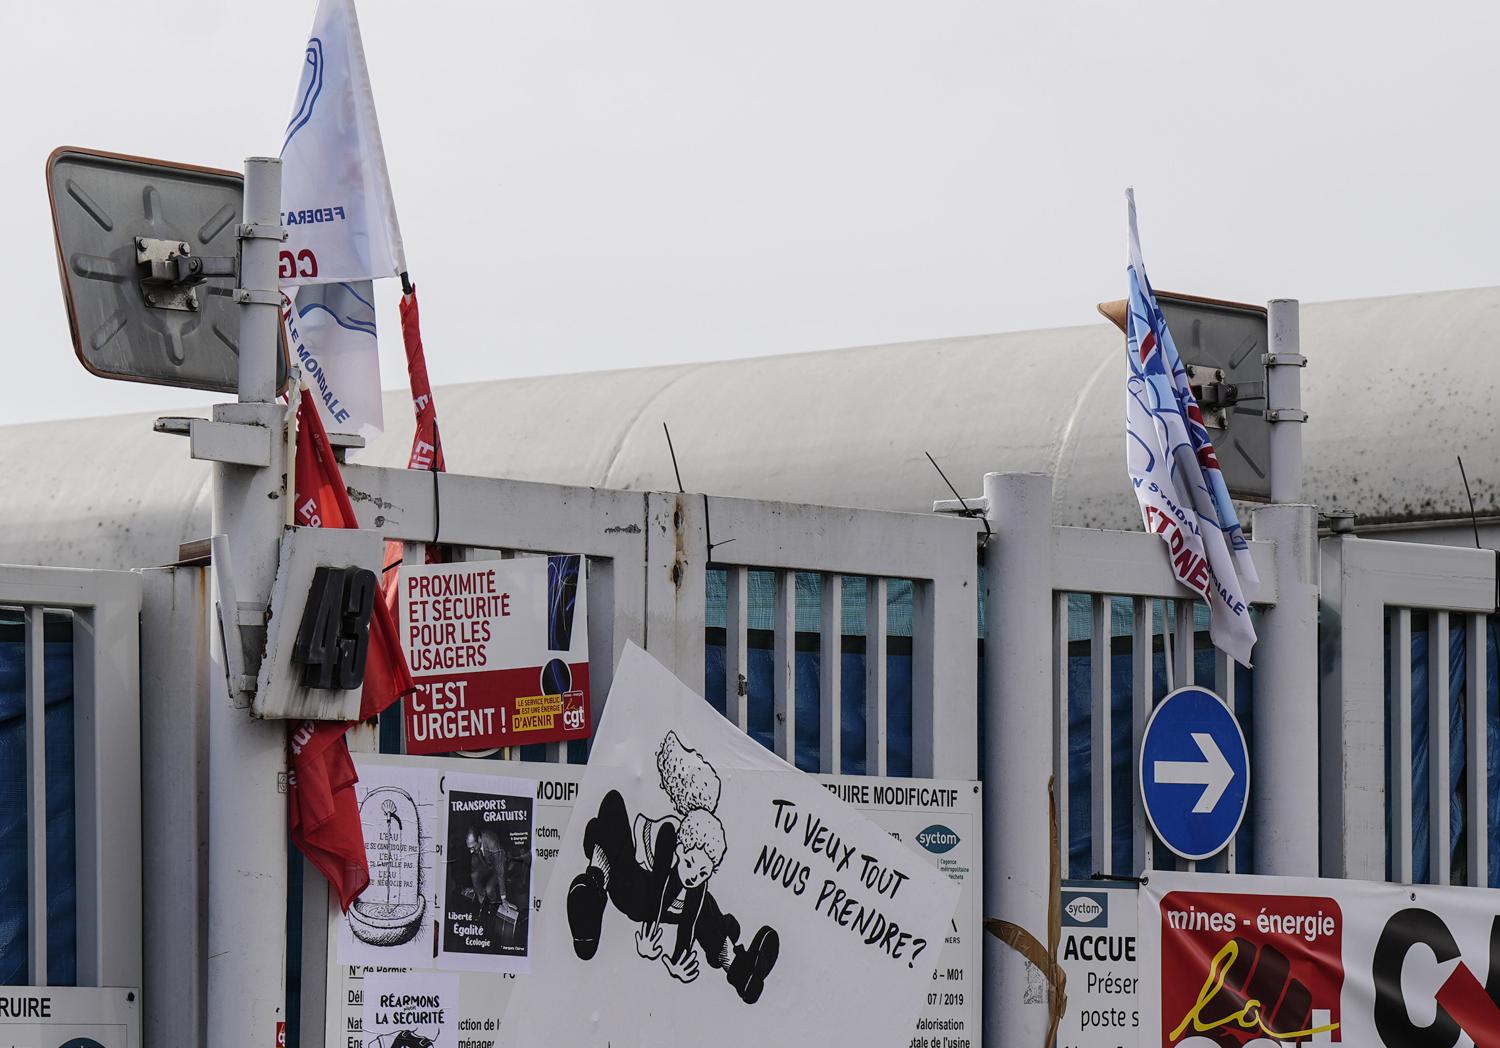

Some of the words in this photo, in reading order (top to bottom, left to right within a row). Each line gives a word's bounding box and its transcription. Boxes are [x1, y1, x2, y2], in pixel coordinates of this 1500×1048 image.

[297, 344, 350, 424] MONDIALE
[408, 570, 496, 598] PROXIMITÉ
[409, 600, 428, 623] ET
[432, 593, 511, 621] SÉCURITÉ
[410, 624, 456, 647] POUR
[461, 620, 491, 643] LES
[410, 645, 487, 671] USAGERS
[412, 681, 468, 711] C'EST
[525, 698, 543, 706] SERVICE
[544, 696, 560, 704] PUBLIC
[531, 706, 540, 714] UNE
[413, 708, 495, 741] URGENT
[501, 706, 507, 733] !
[514, 715, 552, 729] D'AVENIR
[563, 706, 585, 728] cgt
[874, 786, 958, 807] MODIFICATIF
[451, 799, 506, 812] TRANSPORTS
[483, 810, 527, 822] GRATUITS!
[379, 833, 399, 841] L'EAU
[919, 832, 957, 845] syctom
[772, 799, 798, 834] TU
[804, 813, 856, 872] VEUX
[861, 854, 909, 899] TOUT
[379, 853, 399, 861] L'EAU
[378, 870, 397, 879] L'EAU
[754, 846, 811, 895] NOUS
[815, 880, 927, 969] PRENDRE?
[1068, 903, 1100, 916] syctom
[448, 912, 473, 921] Liberté
[453, 923, 484, 936] Égalité
[1167, 906, 1236, 933] mines
[1257, 908, 1335, 942] énergie
[465, 937, 491, 947] Écologie
[1063, 935, 1136, 962] ACCUE
[947, 969, 963, 980] M01
[1169, 939, 1340, 1042] la
[380, 993, 440, 1008] RÉARMONS
[928, 994, 937, 1005] 07
[944, 994, 964, 1005] 2019
[376, 1012, 389, 1024] LA
[484, 1019, 495, 1030] de
[1081, 1007, 1126, 1032] poste
[930, 1037, 941, 1048] de
[943, 1037, 970, 1048] l'usine
